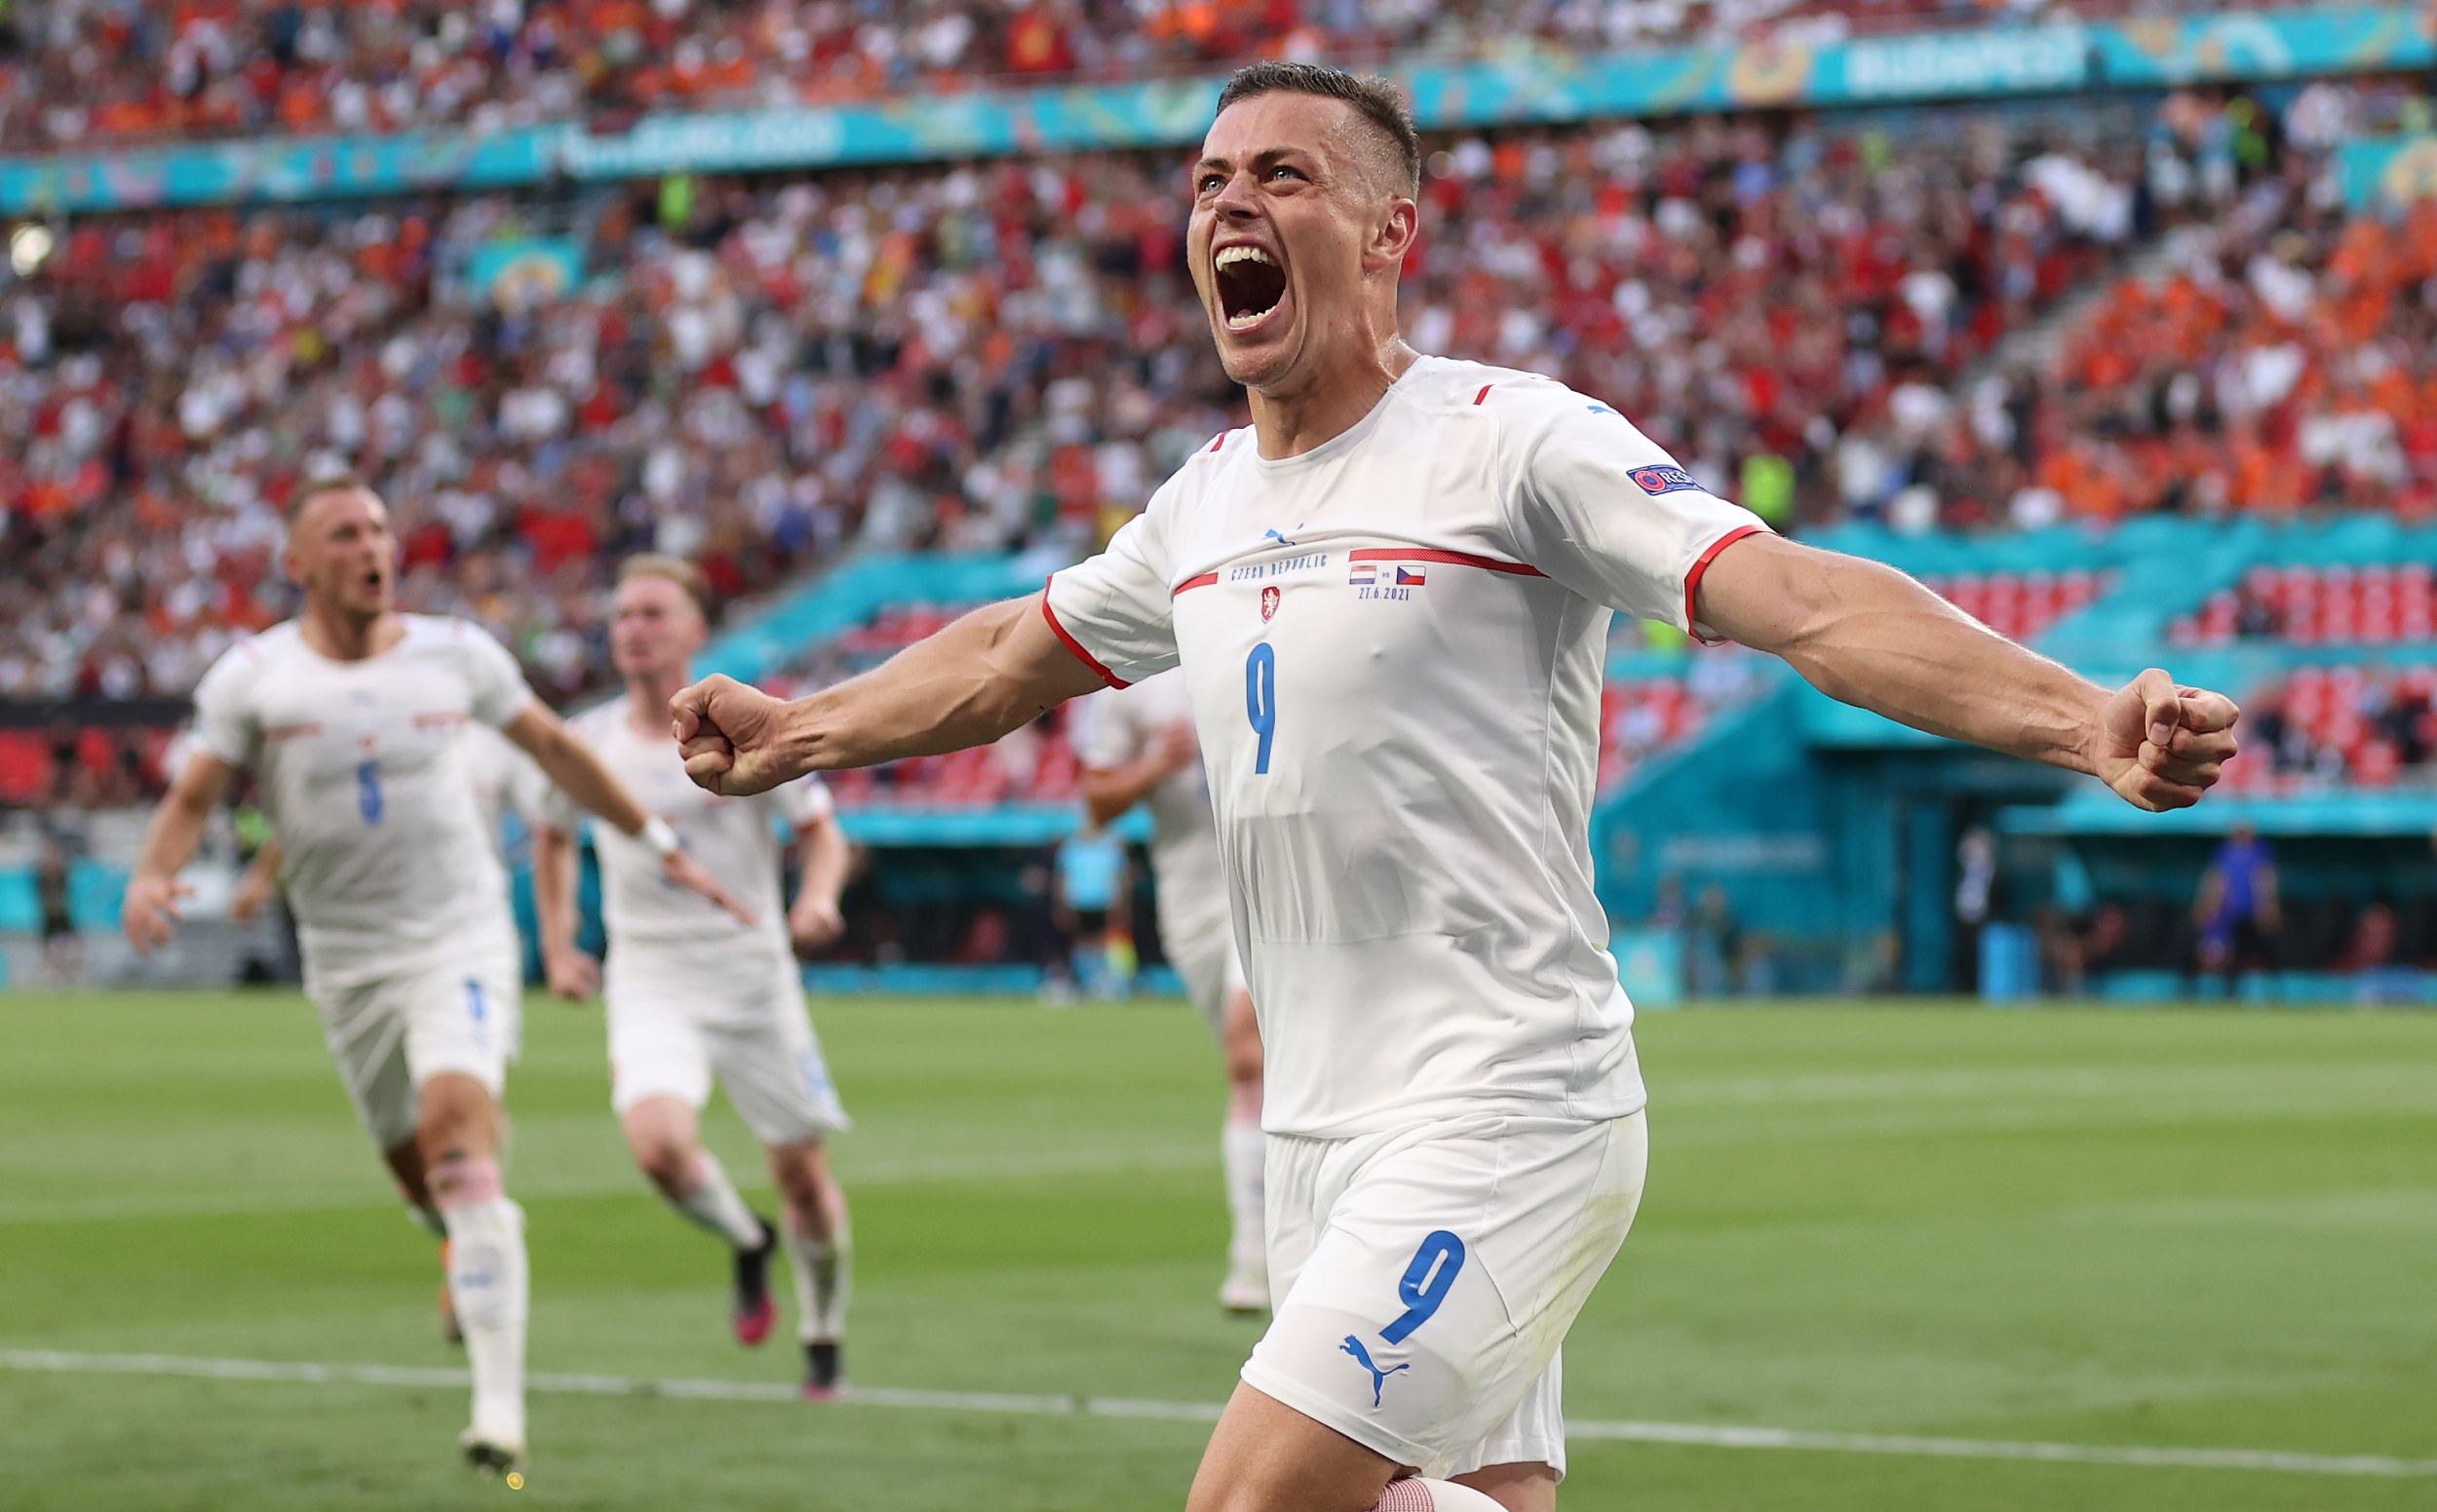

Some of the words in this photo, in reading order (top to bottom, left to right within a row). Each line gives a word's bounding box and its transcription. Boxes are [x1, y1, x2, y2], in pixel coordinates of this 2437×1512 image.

[1231, 564, 1264, 582] CZECH
[1271, 554, 1327, 576] REPUBLIC
[1358, 586, 1410, 601] 27.6.2021
[1246, 641, 1275, 774] 9
[1378, 1229, 1465, 1345] 9
